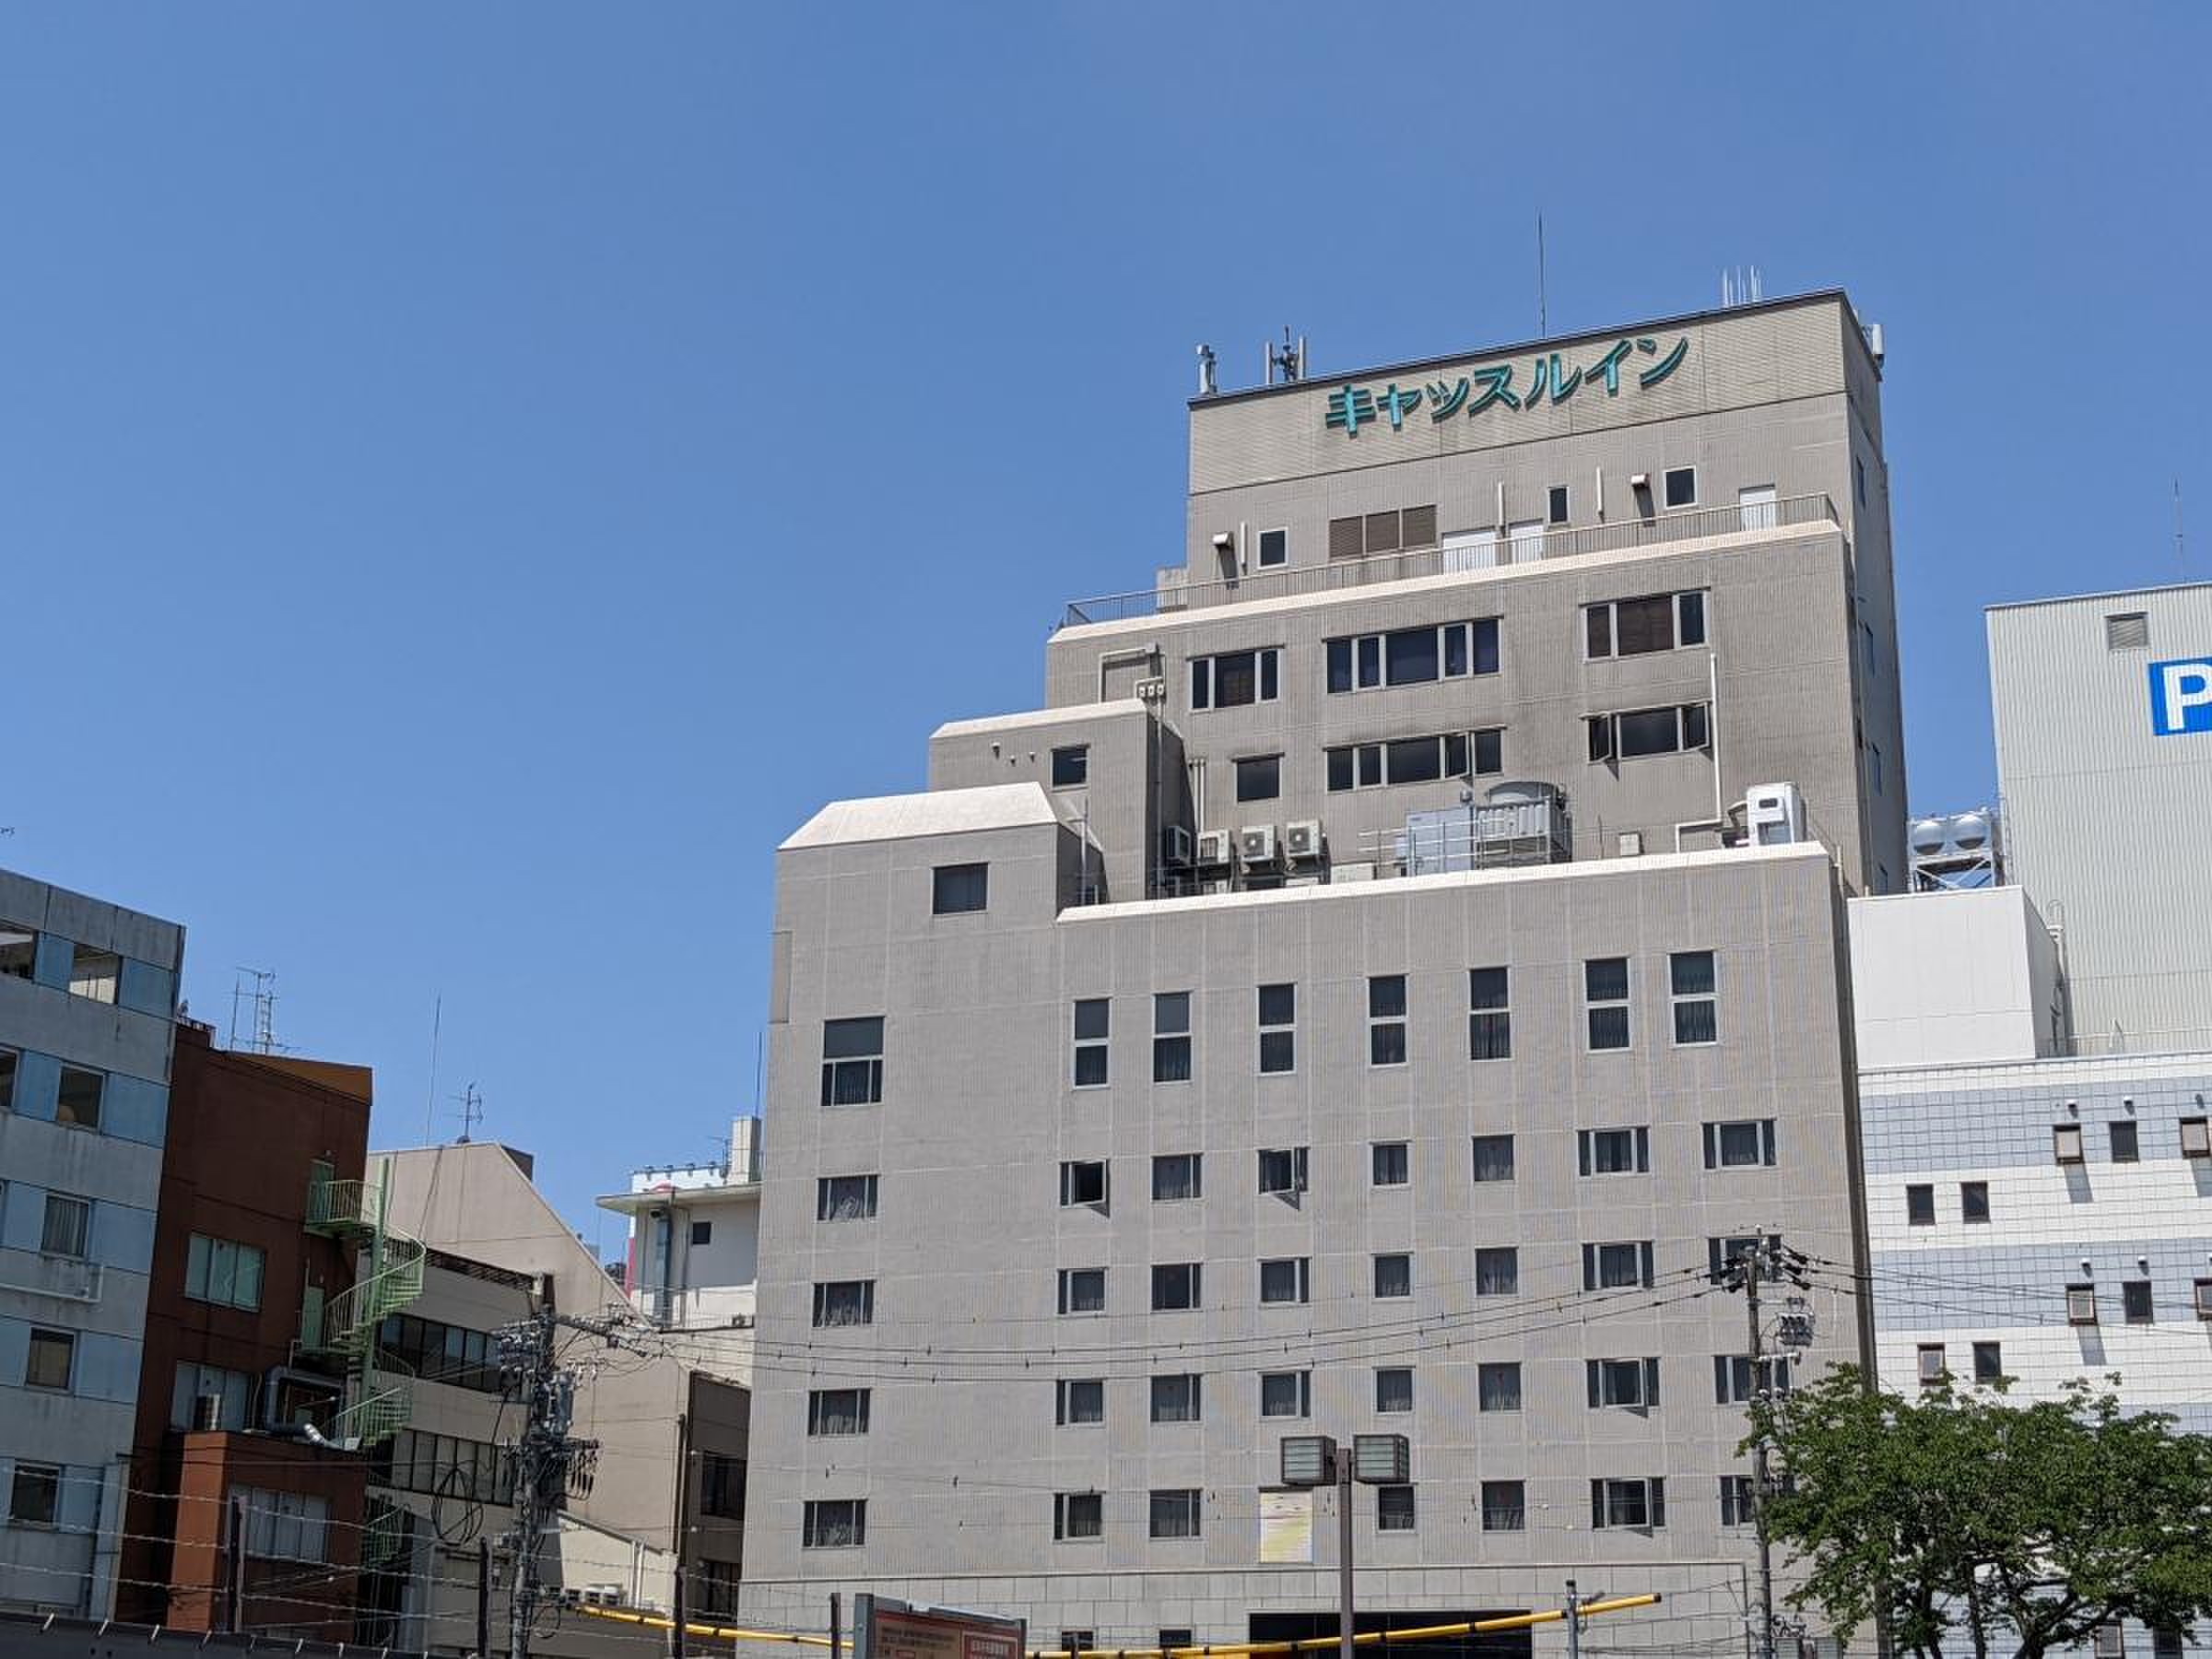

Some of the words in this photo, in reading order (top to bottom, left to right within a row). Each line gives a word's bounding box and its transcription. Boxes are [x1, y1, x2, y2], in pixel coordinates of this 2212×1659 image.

[1325, 337, 1689, 438] キャッスルイン
[2163, 664, 2212, 731] P
